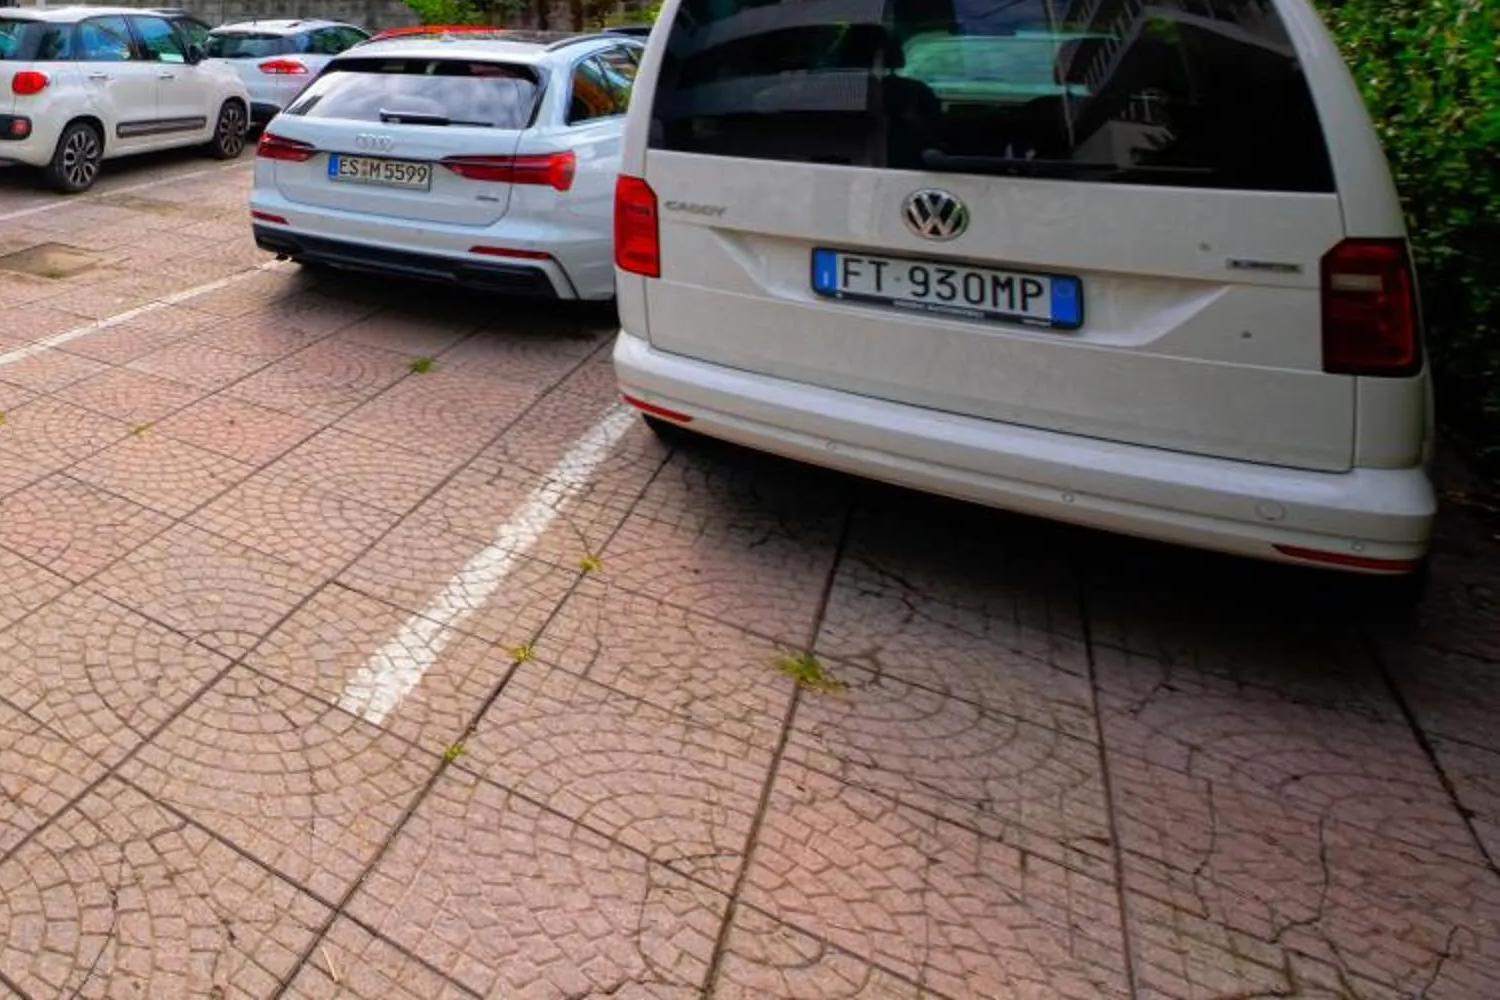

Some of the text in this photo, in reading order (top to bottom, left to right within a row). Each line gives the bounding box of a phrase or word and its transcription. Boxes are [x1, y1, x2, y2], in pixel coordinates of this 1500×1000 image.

[340, 160, 359, 176] ES
[842, 257, 890, 292] FT
[908, 265, 1044, 312] 930MP
